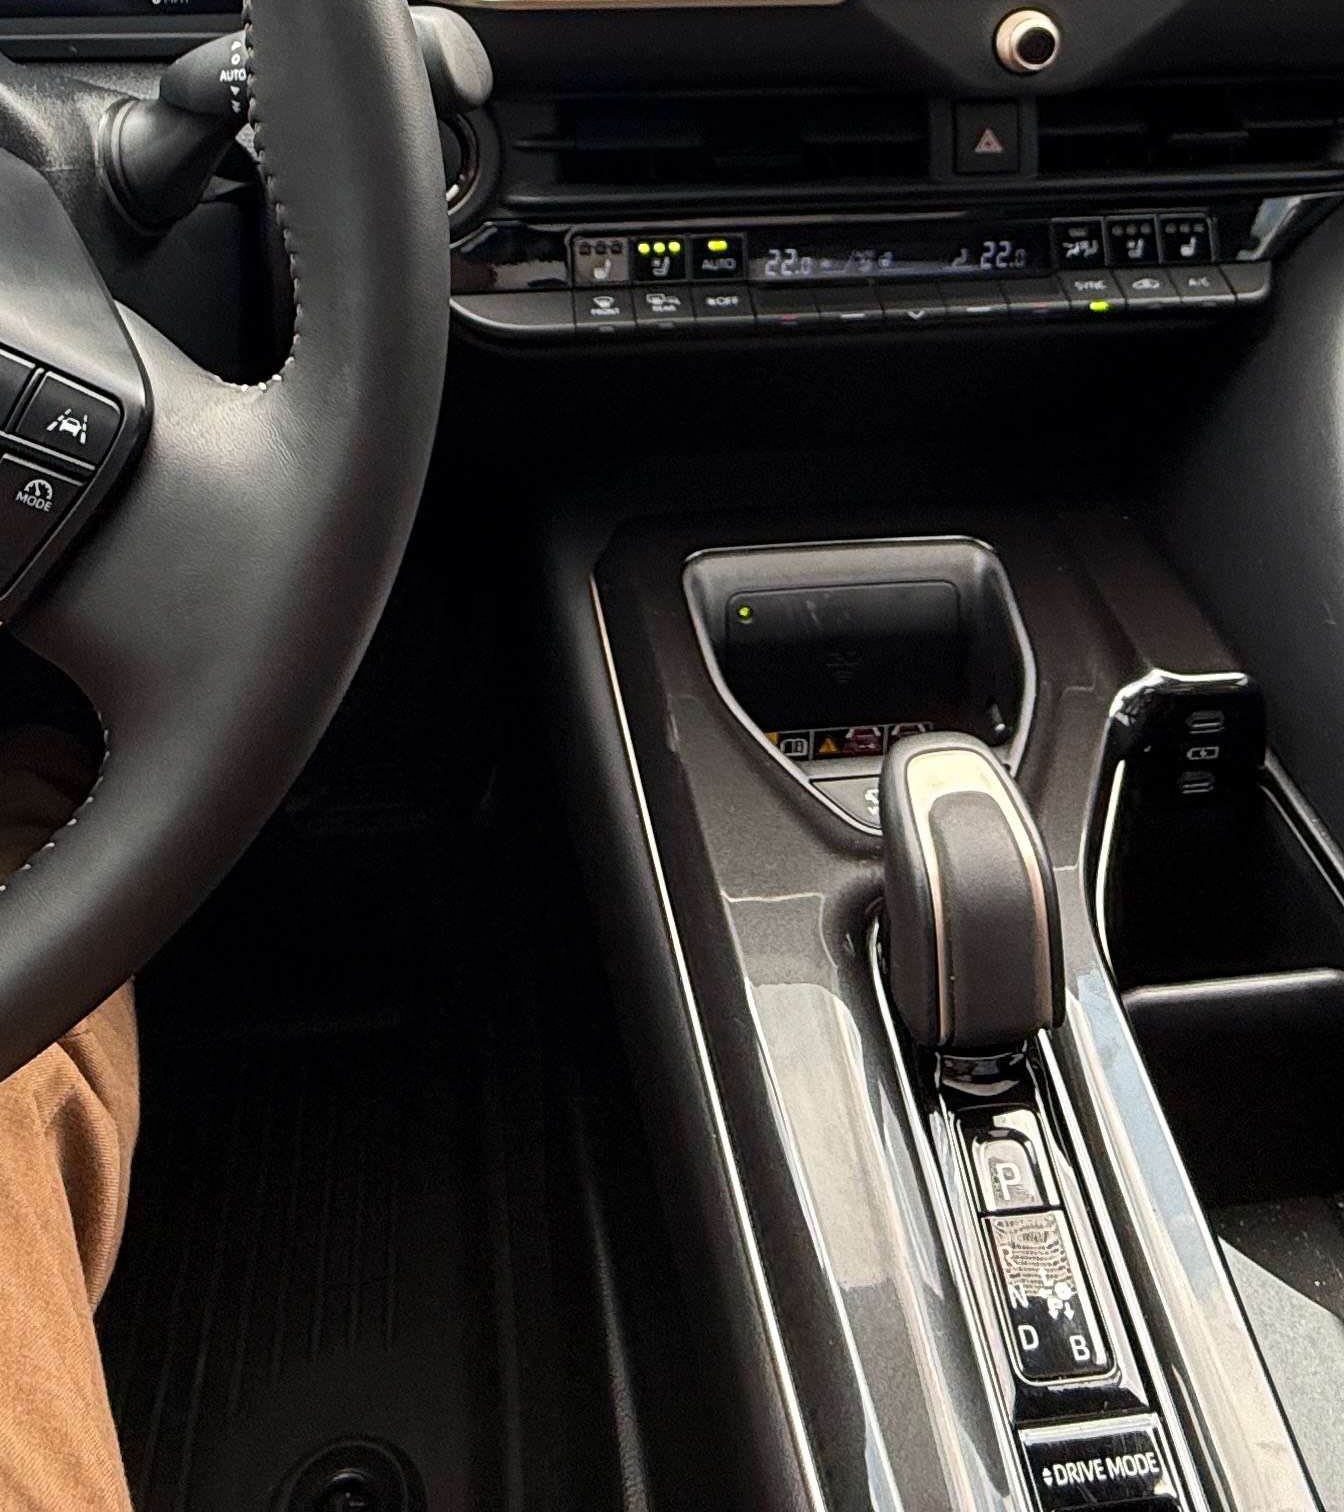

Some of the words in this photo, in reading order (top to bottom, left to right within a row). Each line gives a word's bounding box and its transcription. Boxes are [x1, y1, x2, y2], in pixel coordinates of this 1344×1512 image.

[219, 68, 247, 82] AUTO
[701, 257, 737, 271] AUTO
[765, 248, 812, 276] 22.0
[980, 240, 1027, 269] 22.0
[15, 490, 52, 512] MODE
[996, 1162, 1021, 1200] P
[1007, 1283, 1029, 1309] N
[1017, 1324, 1040, 1351] D
[1069, 1335, 1091, 1362] B
[1053, 1461, 1107, 1487] DRIVE
[1106, 1451, 1159, 1480] MODE
